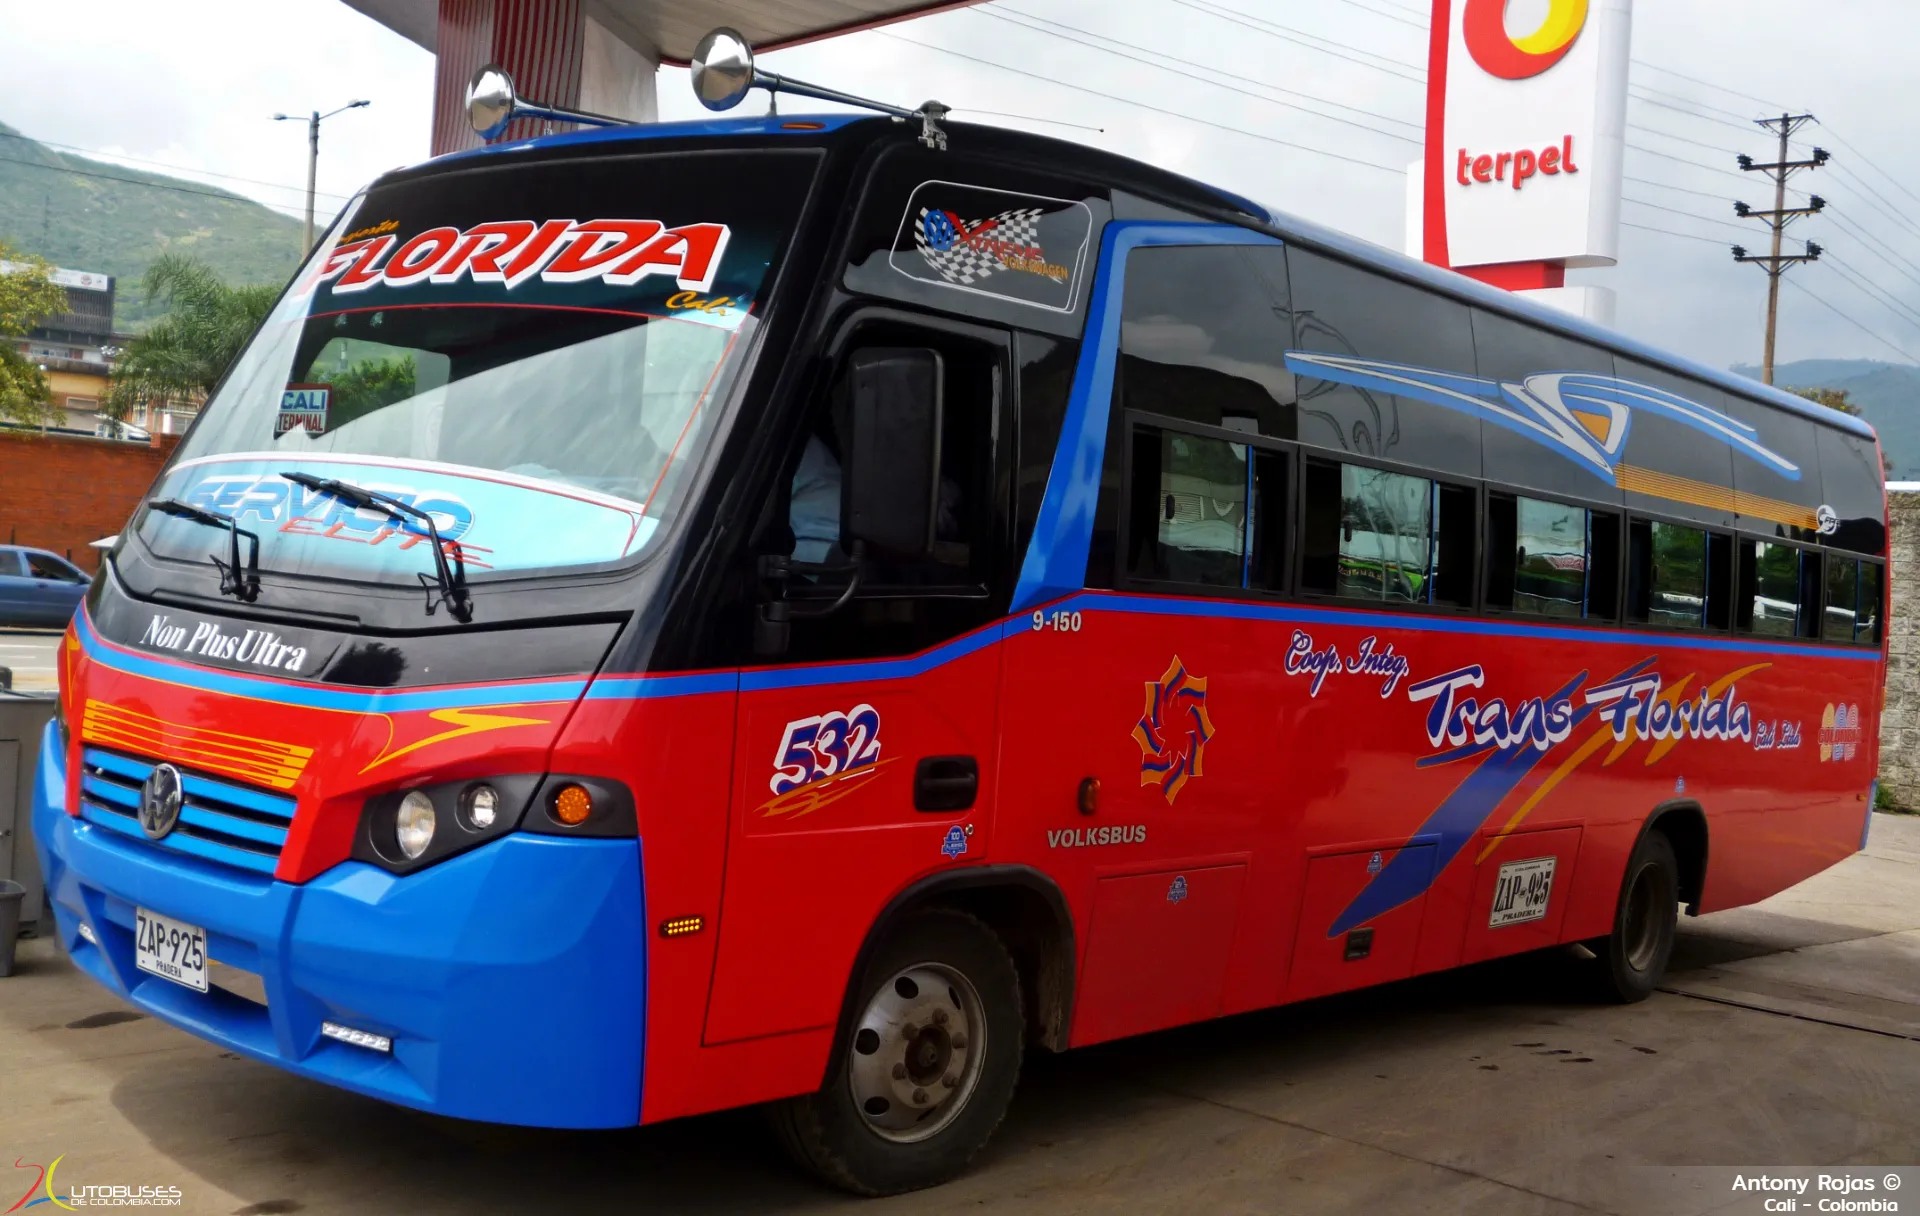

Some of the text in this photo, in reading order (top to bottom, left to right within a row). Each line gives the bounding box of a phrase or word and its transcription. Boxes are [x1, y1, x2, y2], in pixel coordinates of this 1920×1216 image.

[1456, 134, 1578, 190] terpel
[313, 218, 732, 294] FLORIDA
[665, 291, 737, 317] Cali
[280, 391, 327, 410] CALI
[278, 412, 324, 432] TERMINAL
[1032, 610, 1082, 632] 9-150
[139, 614, 307, 671] Non Plus Ultra
[1284, 629, 1409, 699] Coop. Integ.
[1408, 663, 1573, 751] Trans
[1584, 671, 1752, 743] Florida
[769, 703, 882, 796] 532
[1047, 825, 1147, 849] VOLKSBUS
[156, 960, 182, 978] PRADERA
